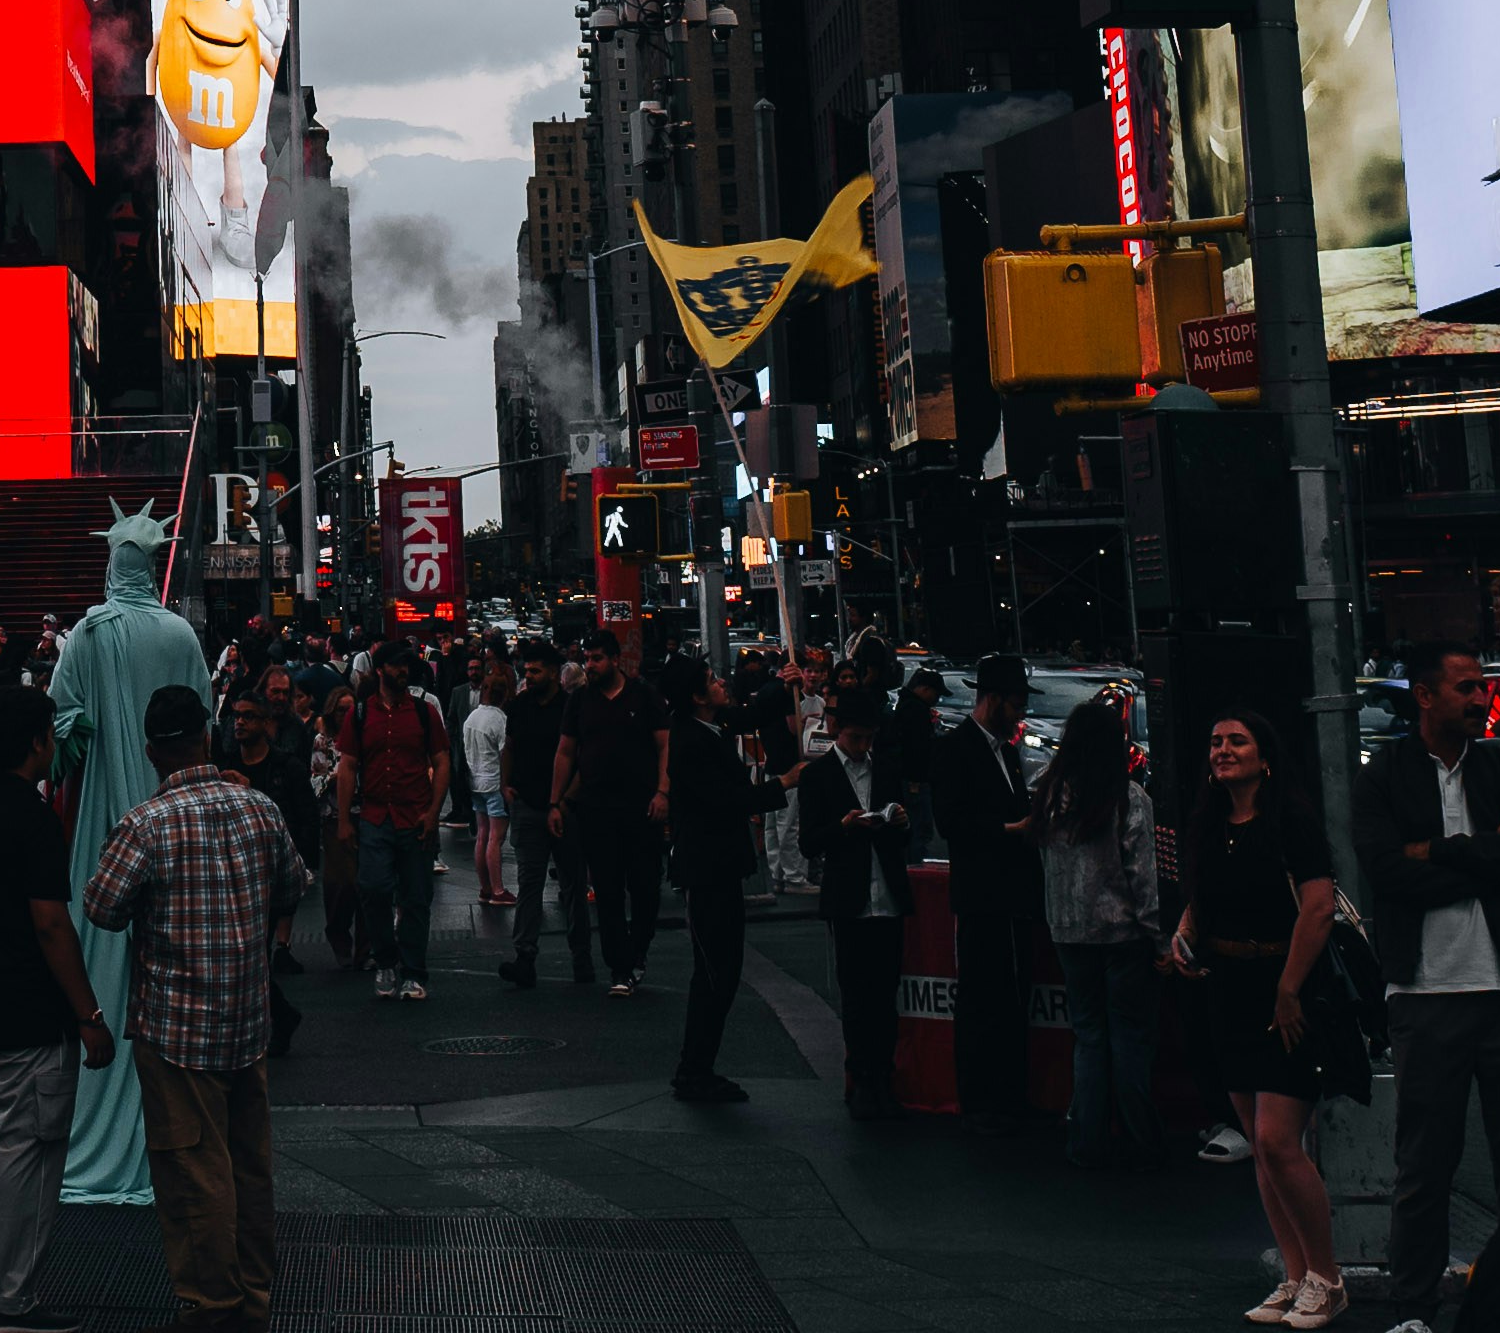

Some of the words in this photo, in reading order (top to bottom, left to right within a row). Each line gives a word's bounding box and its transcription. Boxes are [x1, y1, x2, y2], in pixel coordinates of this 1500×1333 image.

[188, 70, 235, 129] m
[1188, 329, 1209, 349] NO
[1193, 348, 1254, 373] Anytime
[655, 392, 687, 410] ONE
[653, 431, 682, 441] STANDING
[402, 486, 449, 592] tkts
